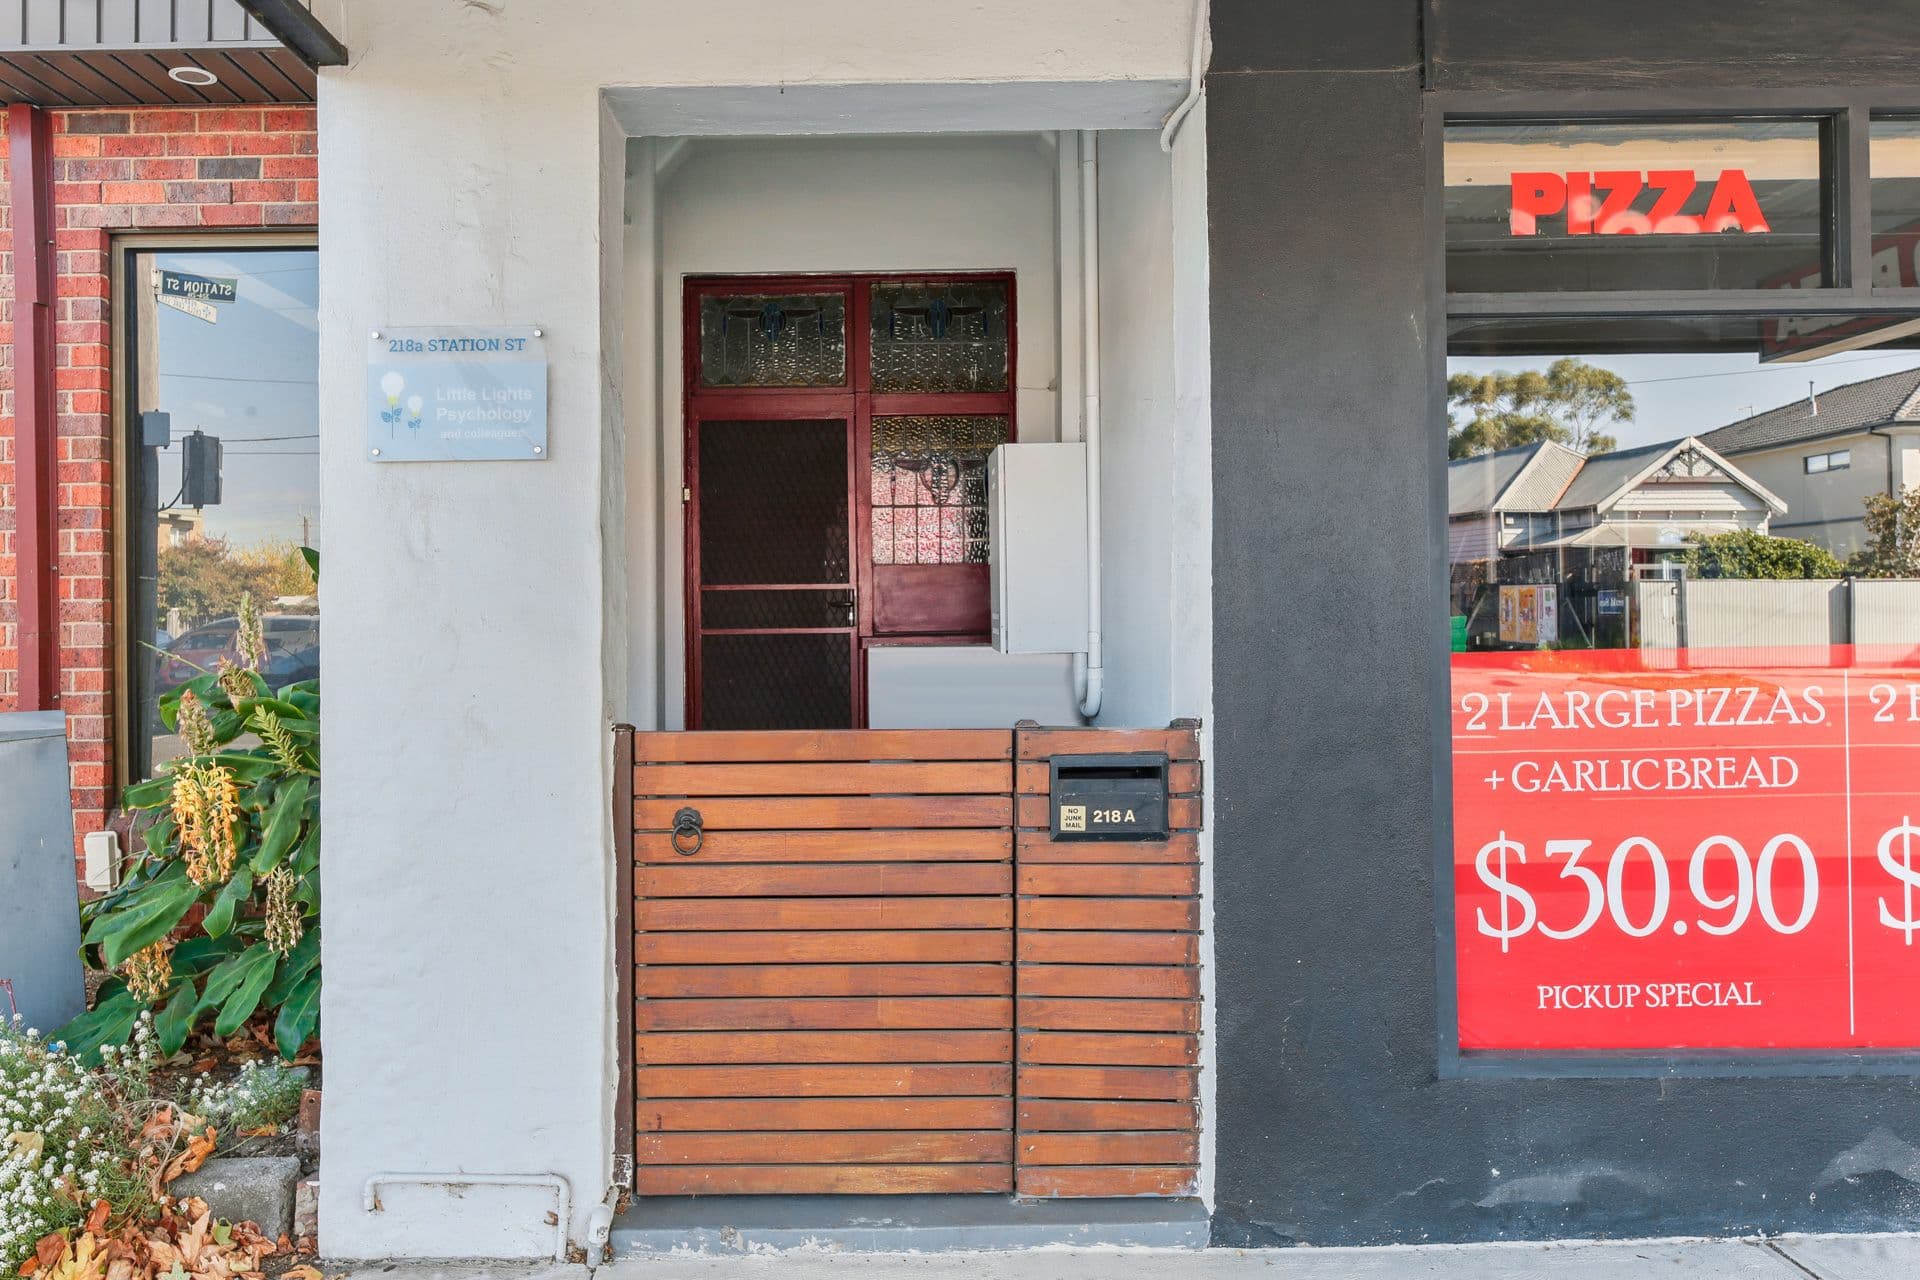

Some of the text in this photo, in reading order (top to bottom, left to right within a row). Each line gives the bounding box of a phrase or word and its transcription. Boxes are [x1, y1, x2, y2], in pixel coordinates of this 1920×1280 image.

[1510, 169, 1771, 236] PIZZA
[388, 338, 526, 352] 218a STATION ST
[437, 386, 533, 404] Little Lights
[437, 407, 532, 424] Psychology
[1460, 692, 1490, 731] 2
[1498, 688, 1660, 731] LARGE
[1869, 684, 1897, 722] 2
[1511, 758, 1660, 793] GARLIC
[1666, 756, 1799, 790] BREAD
[1093, 810, 1136, 823] 218 A
[1475, 830, 1819, 953] $30.90
[1537, 982, 1762, 1009] PICKUP SPECIAL
